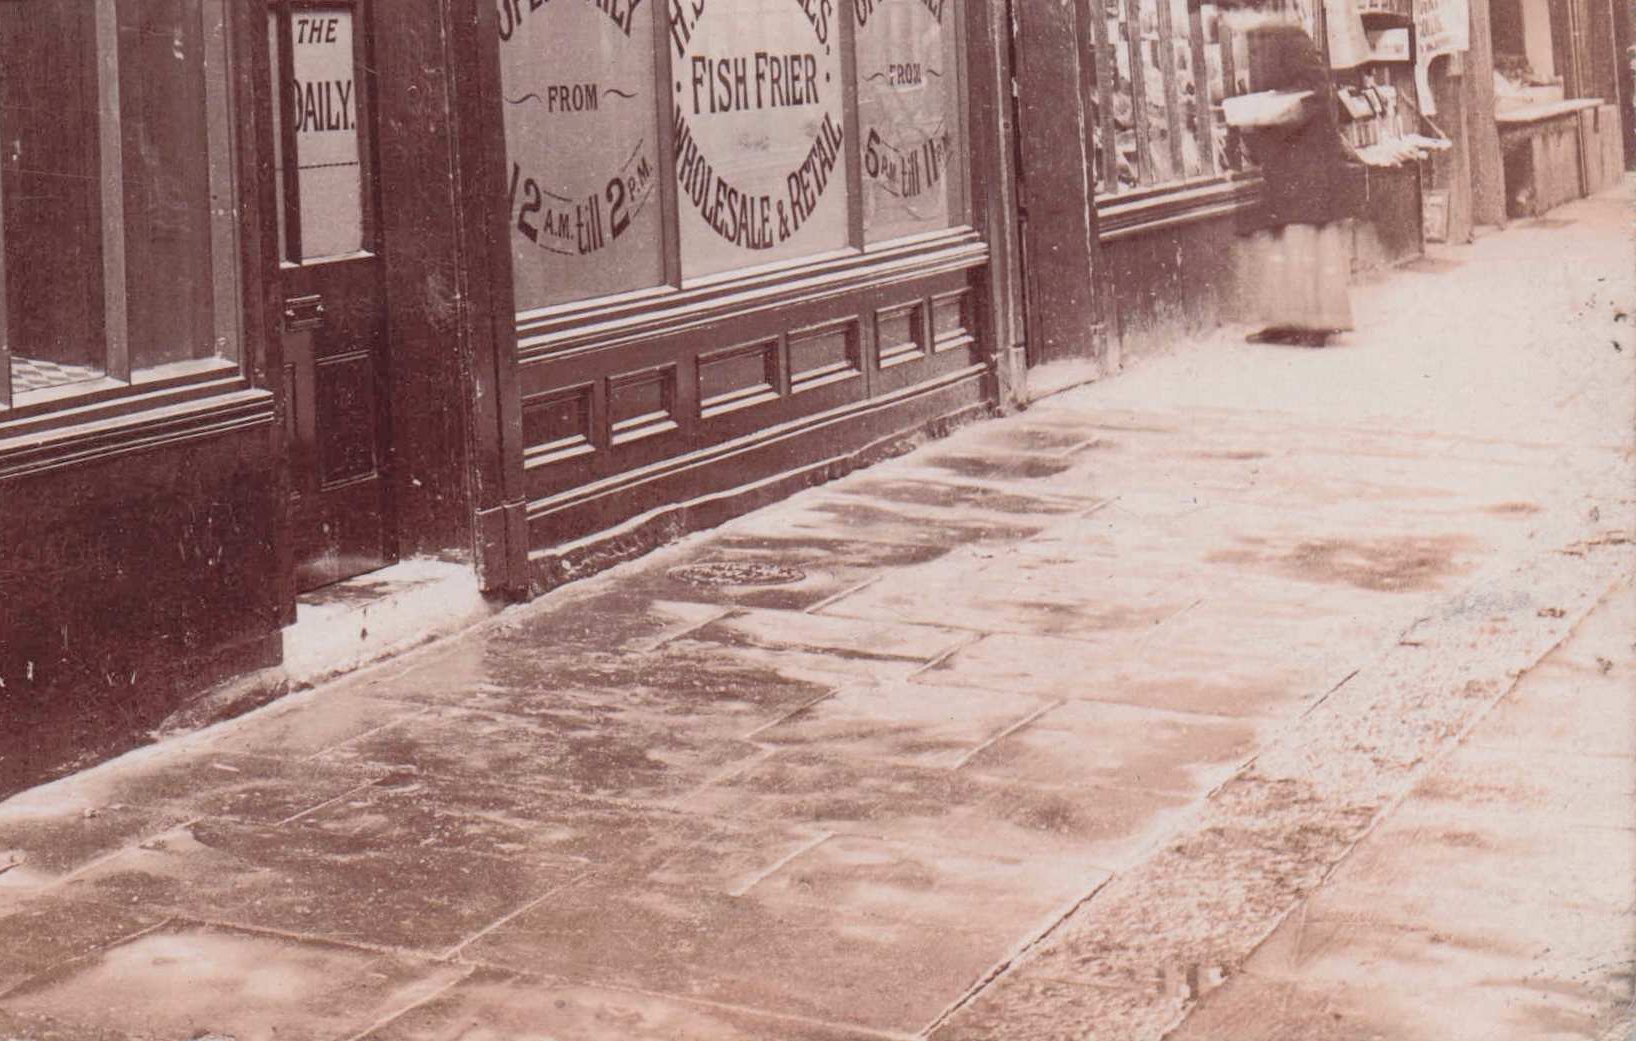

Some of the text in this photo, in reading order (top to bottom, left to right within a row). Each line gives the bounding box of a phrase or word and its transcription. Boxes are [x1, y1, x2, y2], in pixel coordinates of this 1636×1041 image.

[297, 18, 339, 44] THE
[547, 84, 599, 112] FROM
[691, 51, 820, 115] FISH FRIER
[889, 63, 923, 87] FROM
[675, 104, 844, 251] WHOLESALE & RETAIL
[901, 150, 921, 198] till
[923, 138, 940, 189] 11
[576, 194, 605, 256] till
[605, 176, 631, 241] 2
